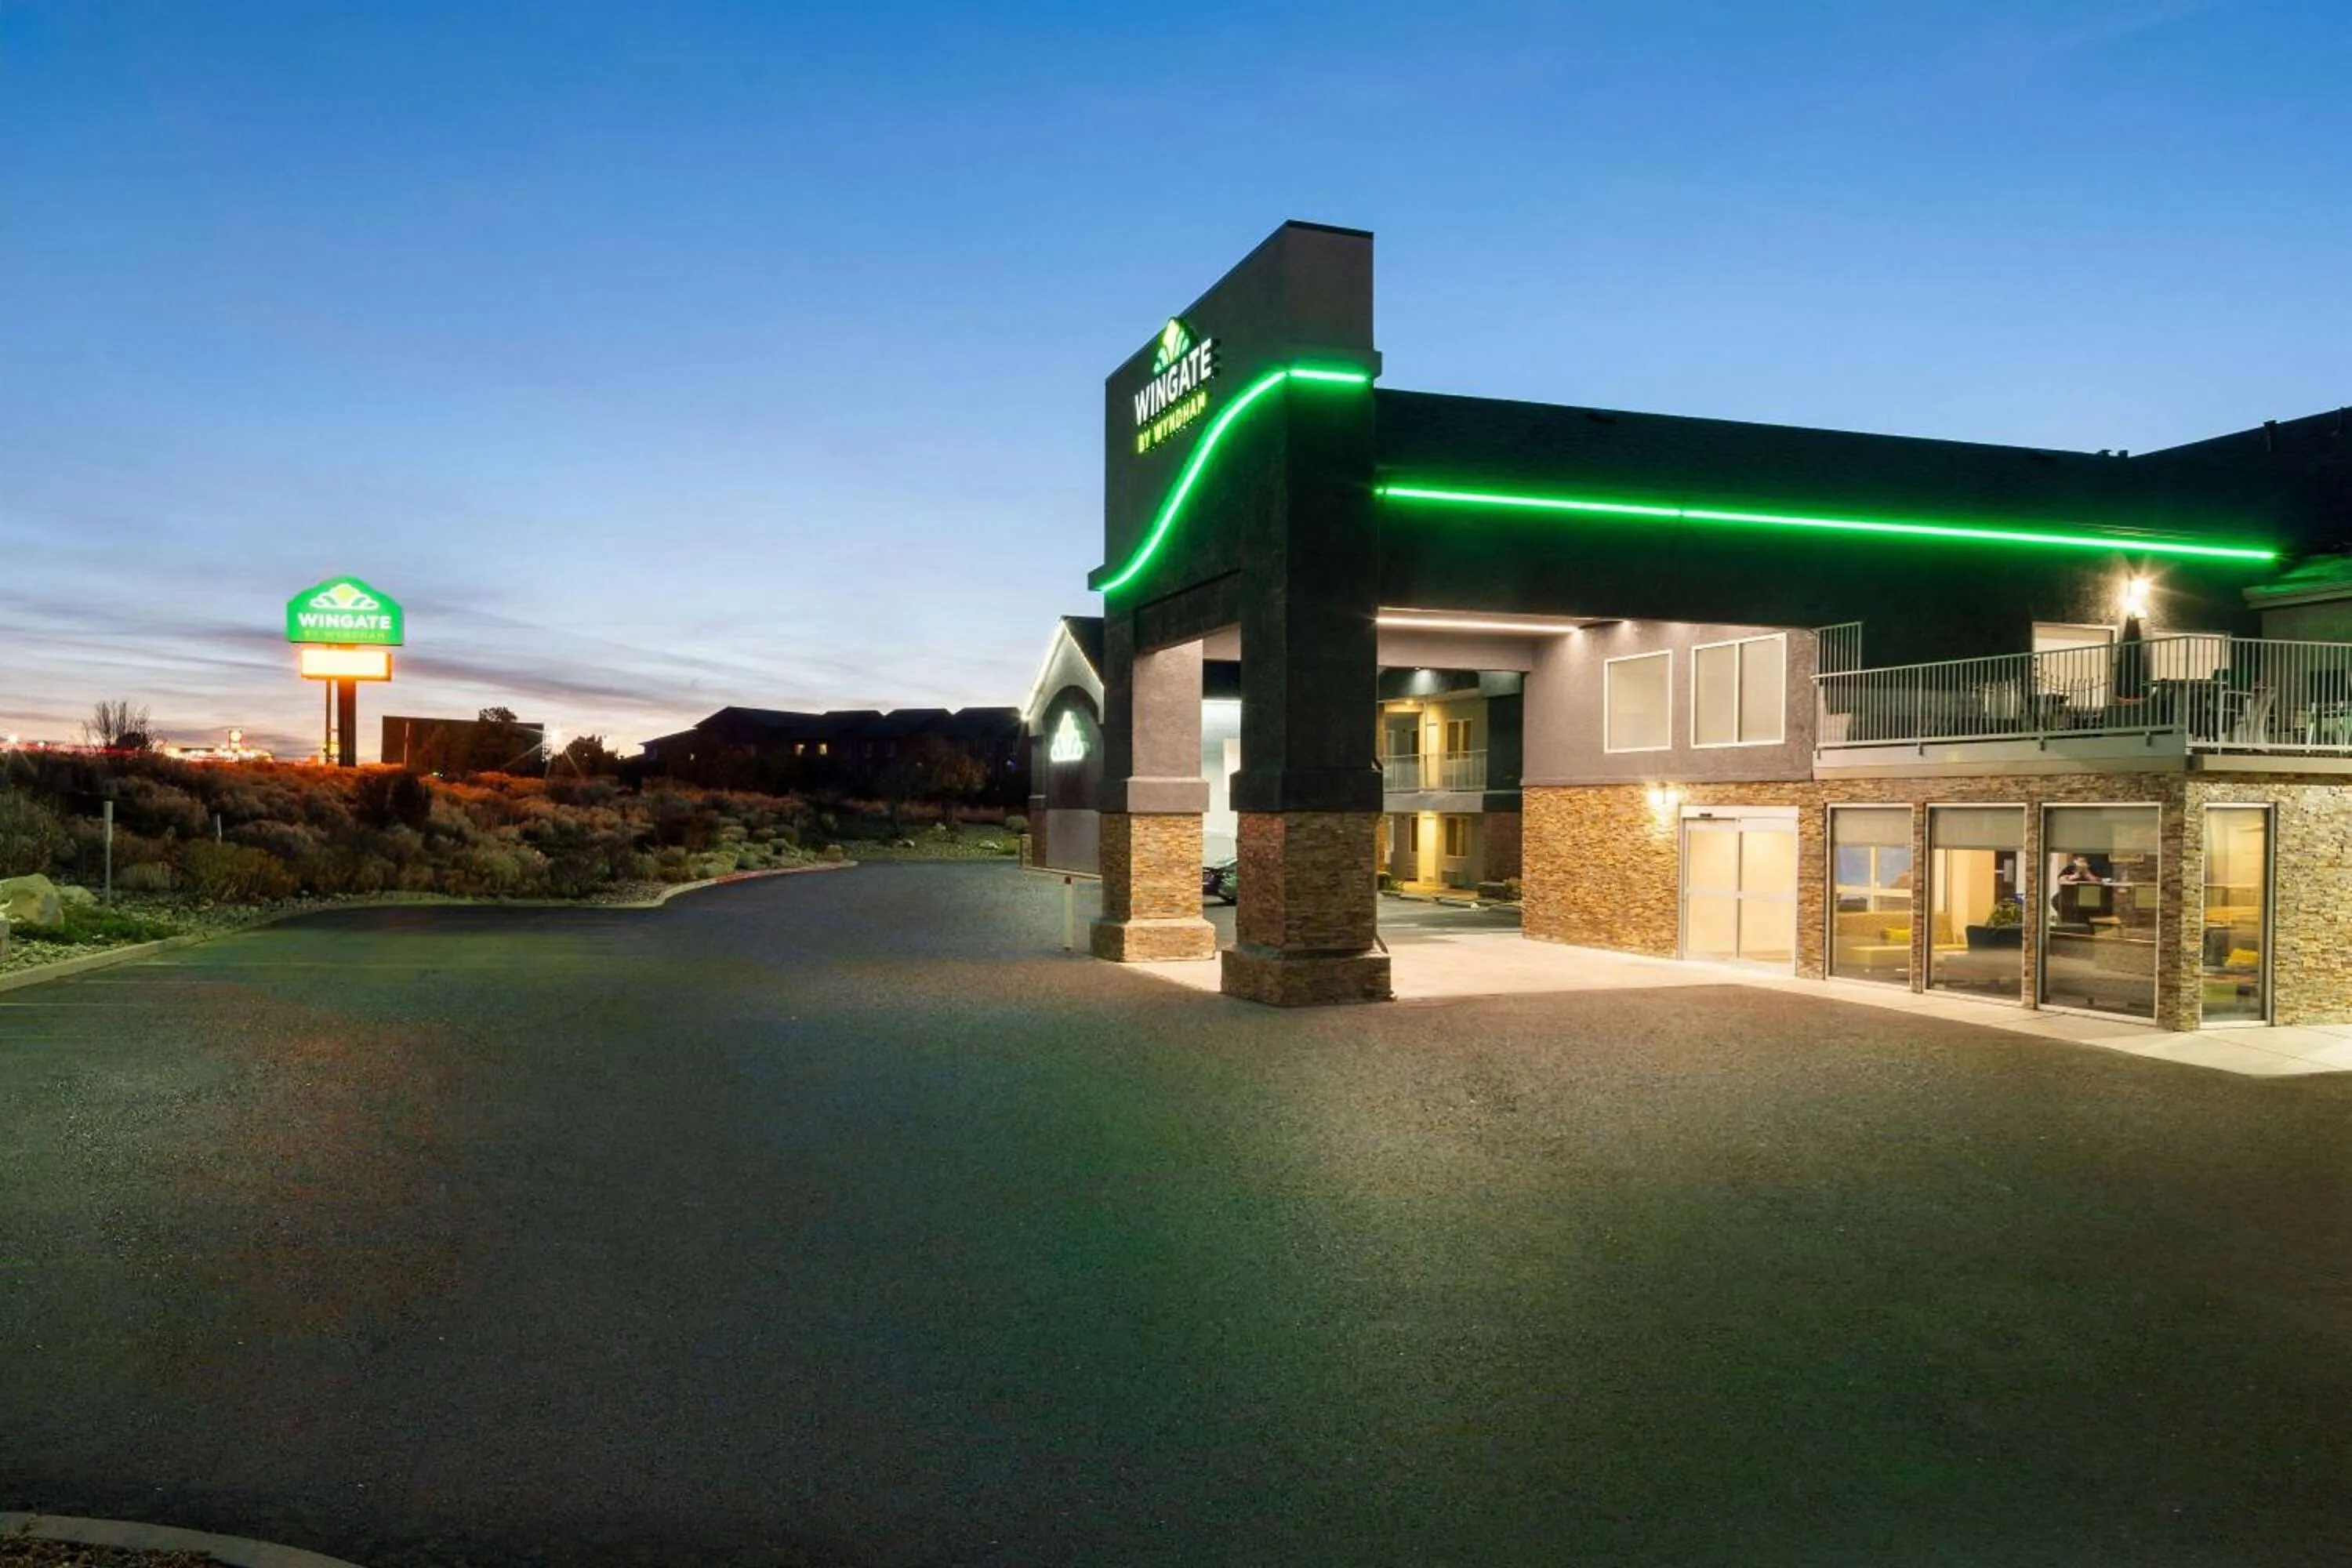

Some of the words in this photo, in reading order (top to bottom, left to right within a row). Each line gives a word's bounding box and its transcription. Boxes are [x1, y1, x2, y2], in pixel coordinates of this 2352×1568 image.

[1134, 338, 1212, 426] WINGATE
[1138, 429, 1151, 453] BY
[297, 612, 392, 630] WINGATE
